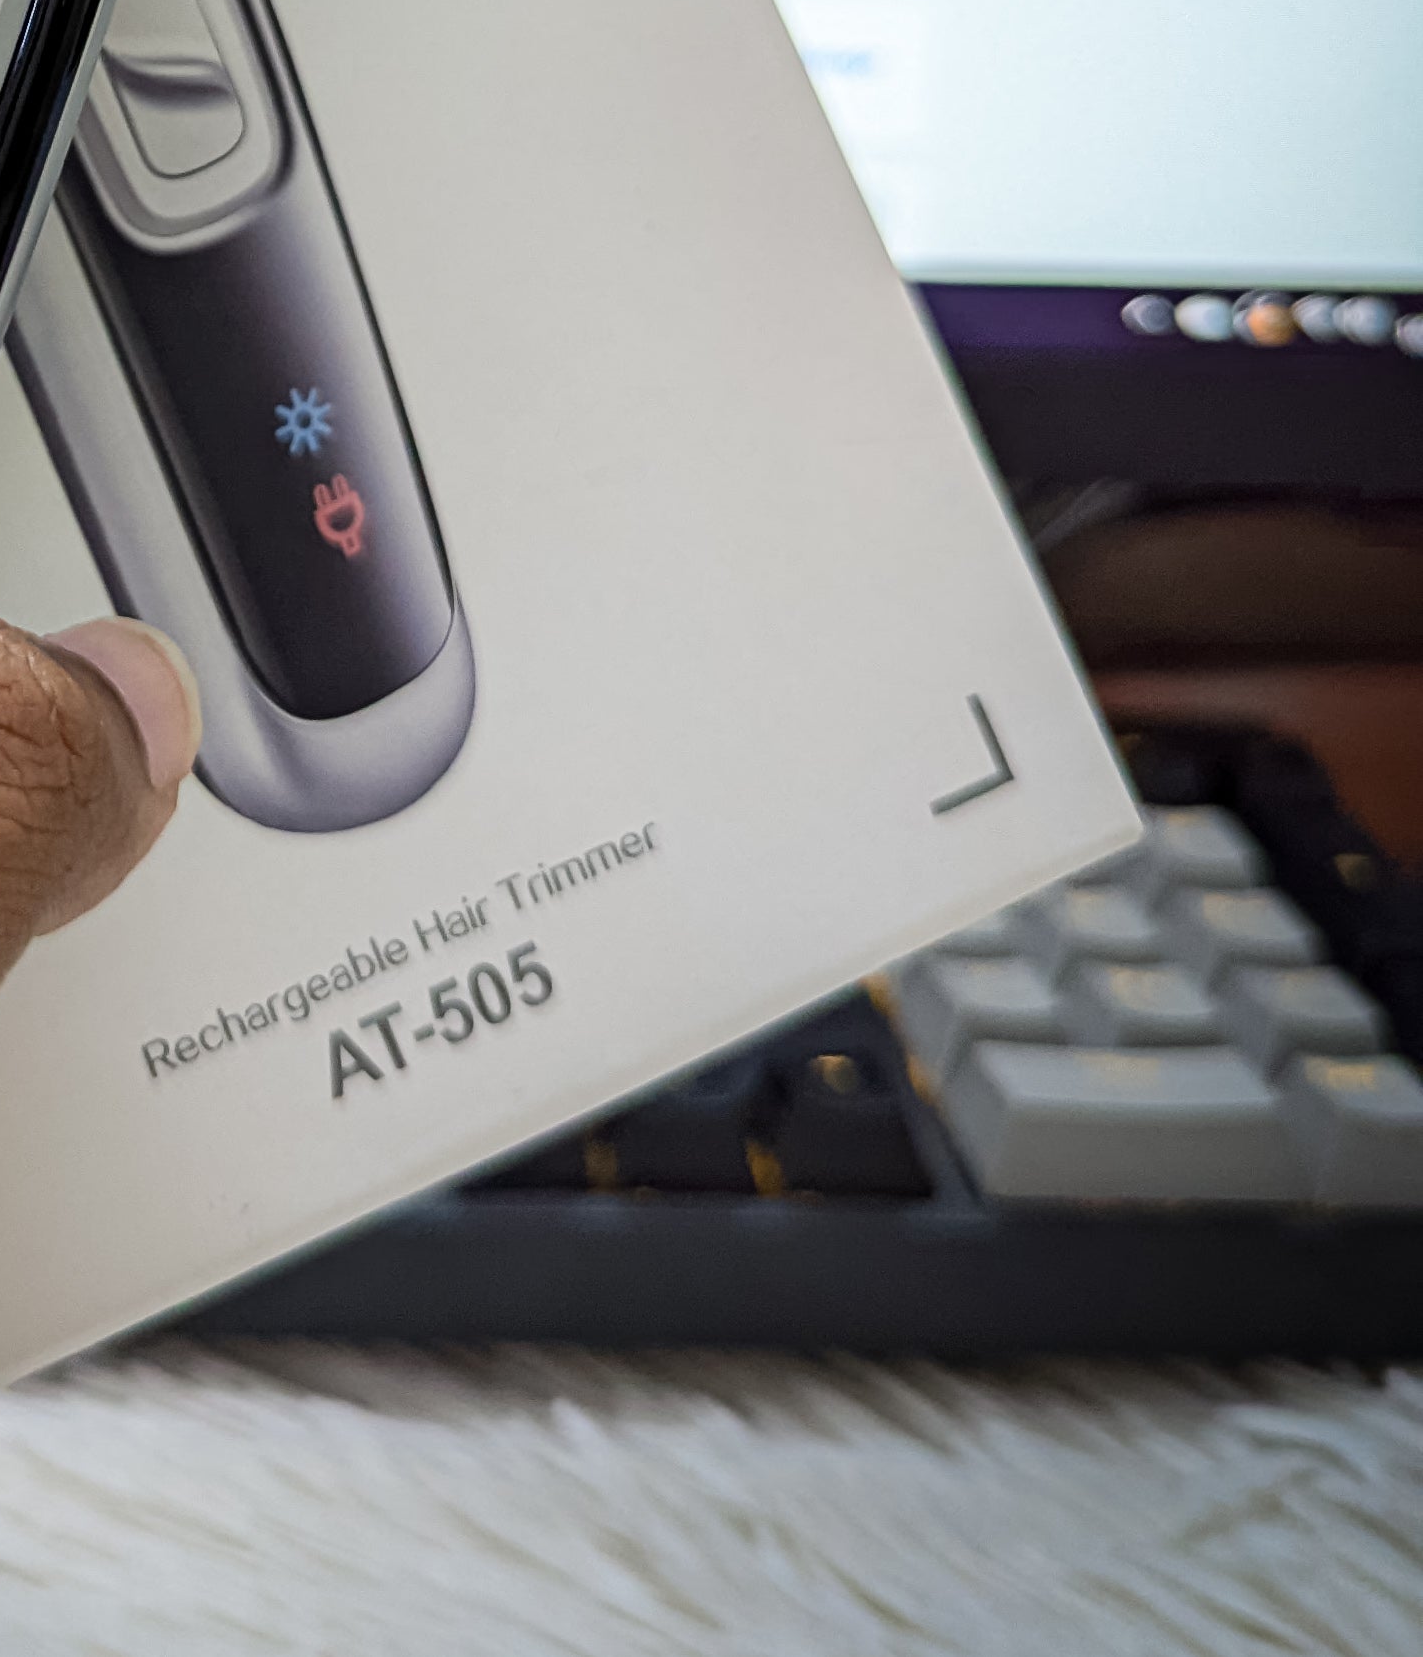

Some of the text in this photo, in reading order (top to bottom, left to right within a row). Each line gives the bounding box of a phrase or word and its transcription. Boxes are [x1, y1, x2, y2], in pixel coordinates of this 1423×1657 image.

[140, 821, 657, 1079] Rechargeable Hair Trimmer
[326, 940, 554, 1099] AT-505
